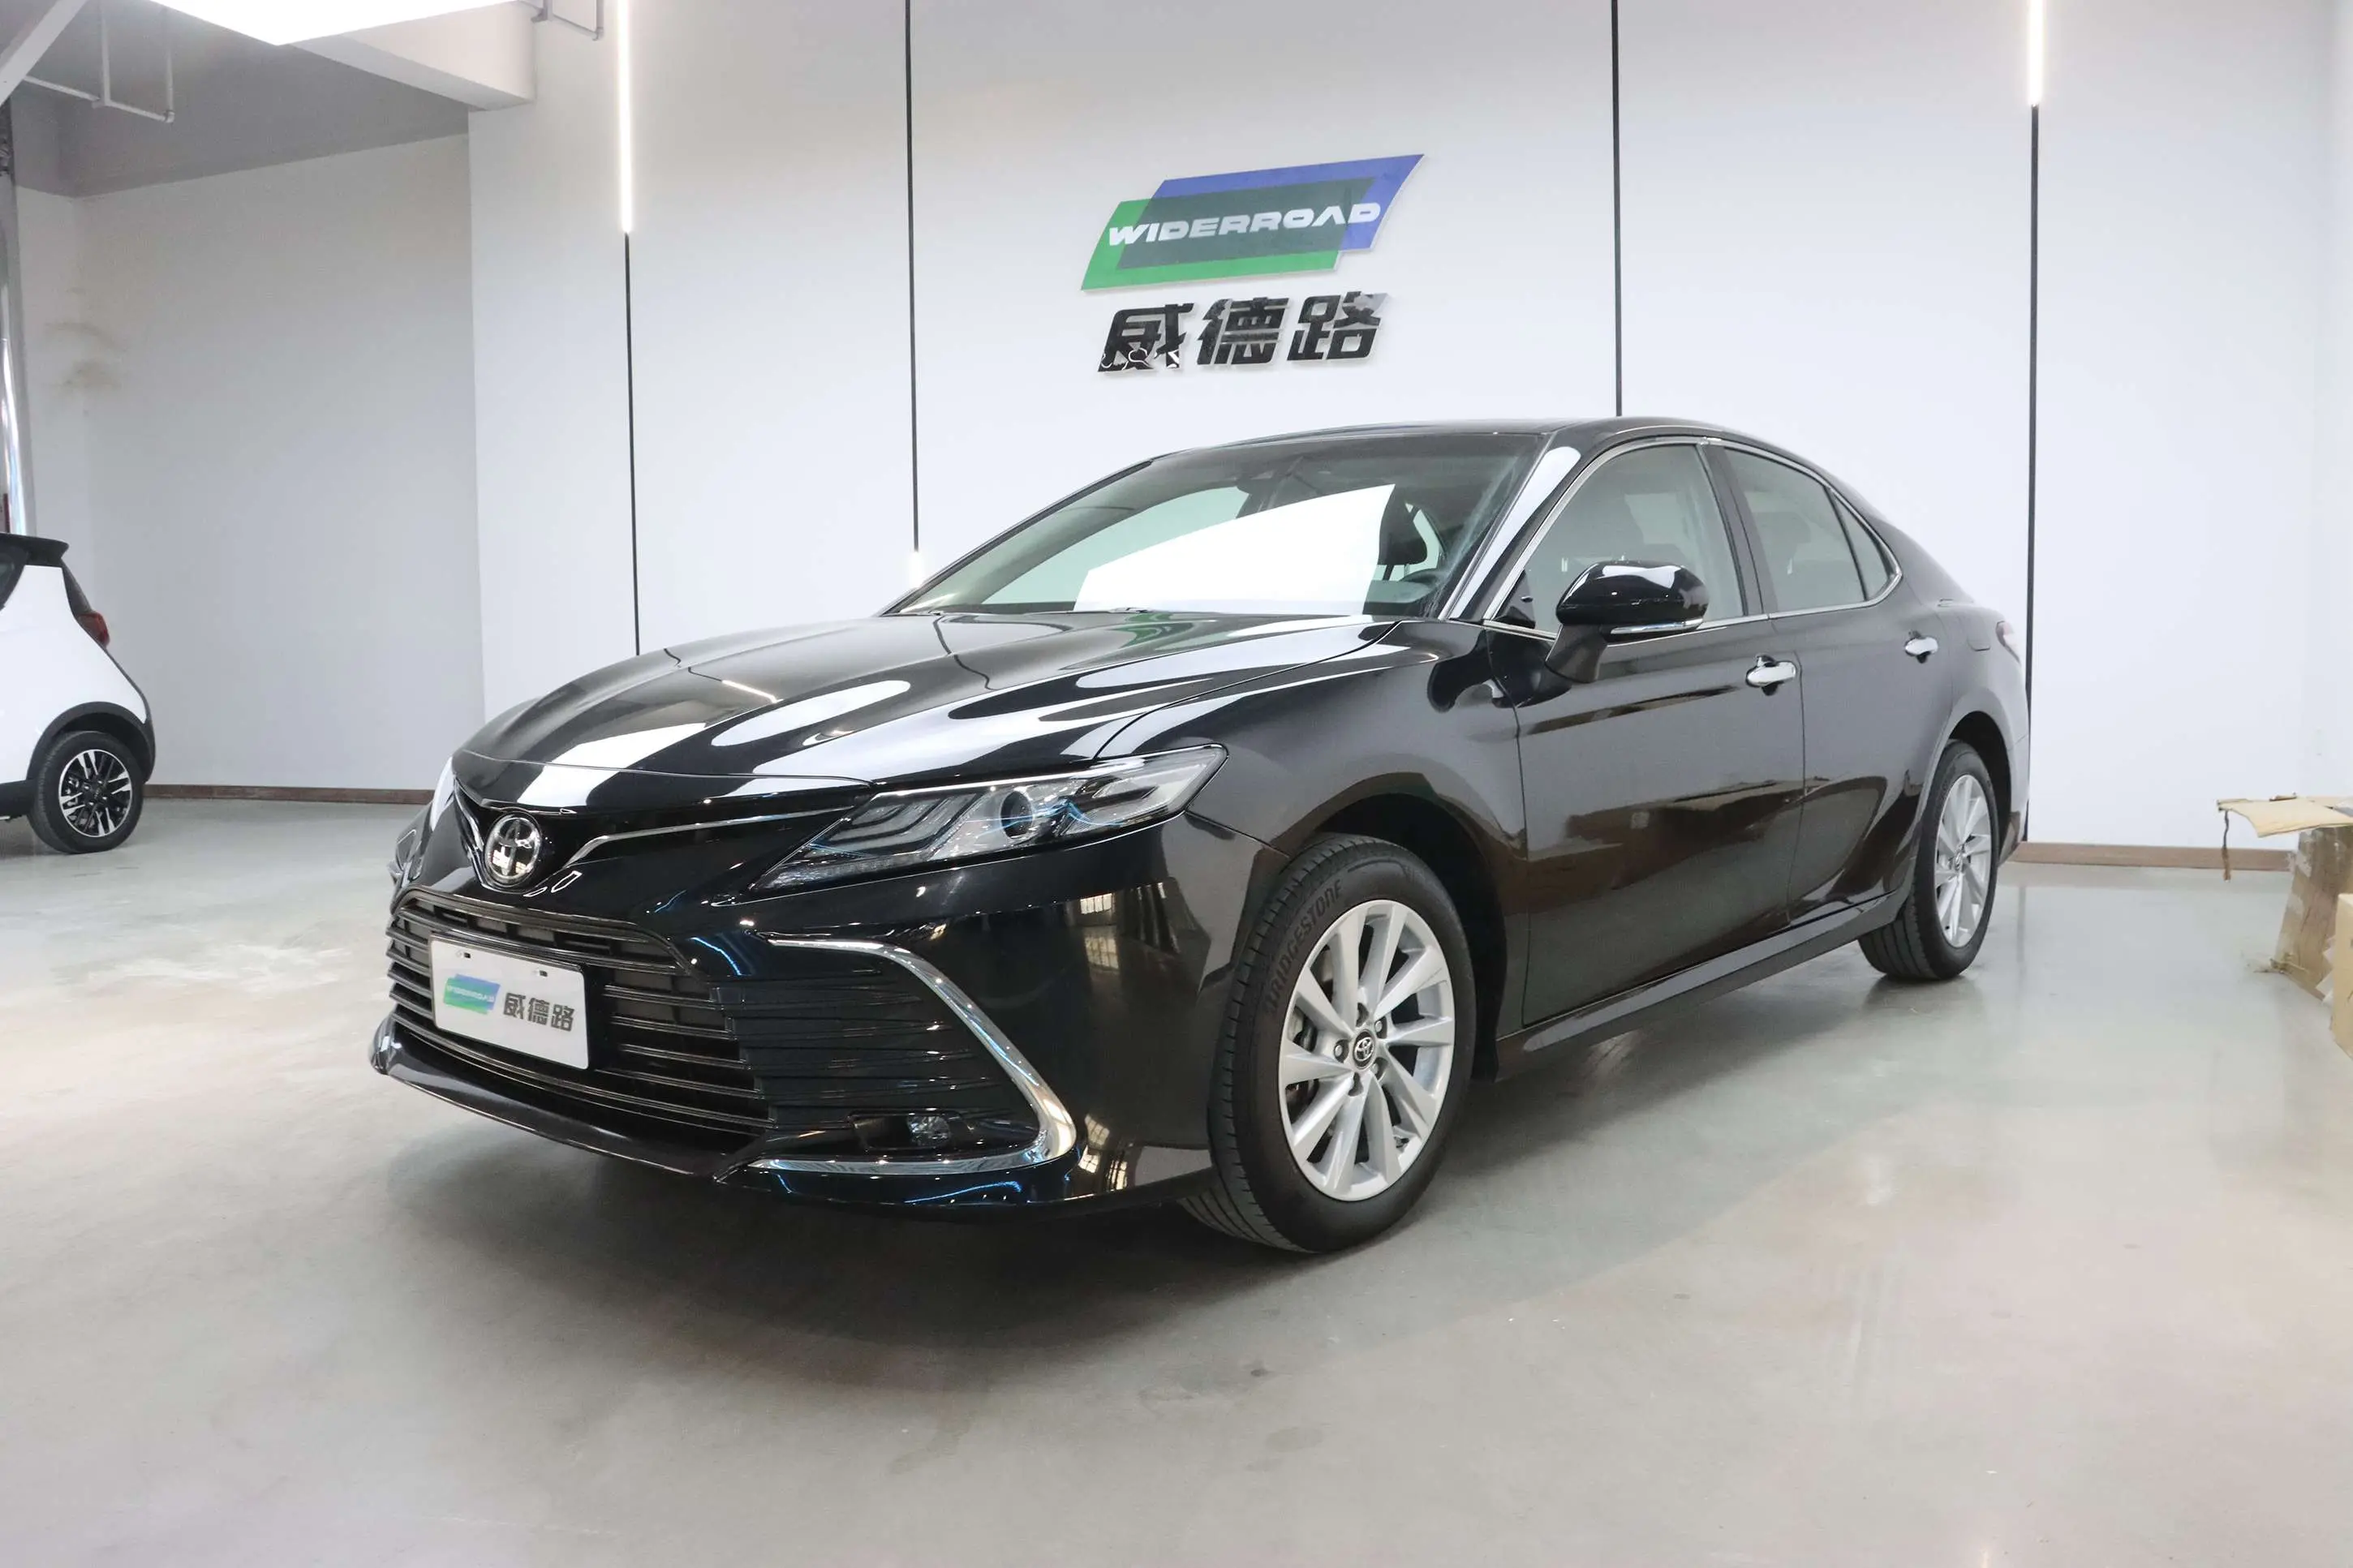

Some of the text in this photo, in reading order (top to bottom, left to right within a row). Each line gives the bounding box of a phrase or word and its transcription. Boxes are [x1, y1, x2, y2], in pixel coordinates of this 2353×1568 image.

[1108, 202, 1381, 246] WIDERROAD
[1097, 291, 1388, 372] 威德路
[503, 992, 575, 1032] 威德路
